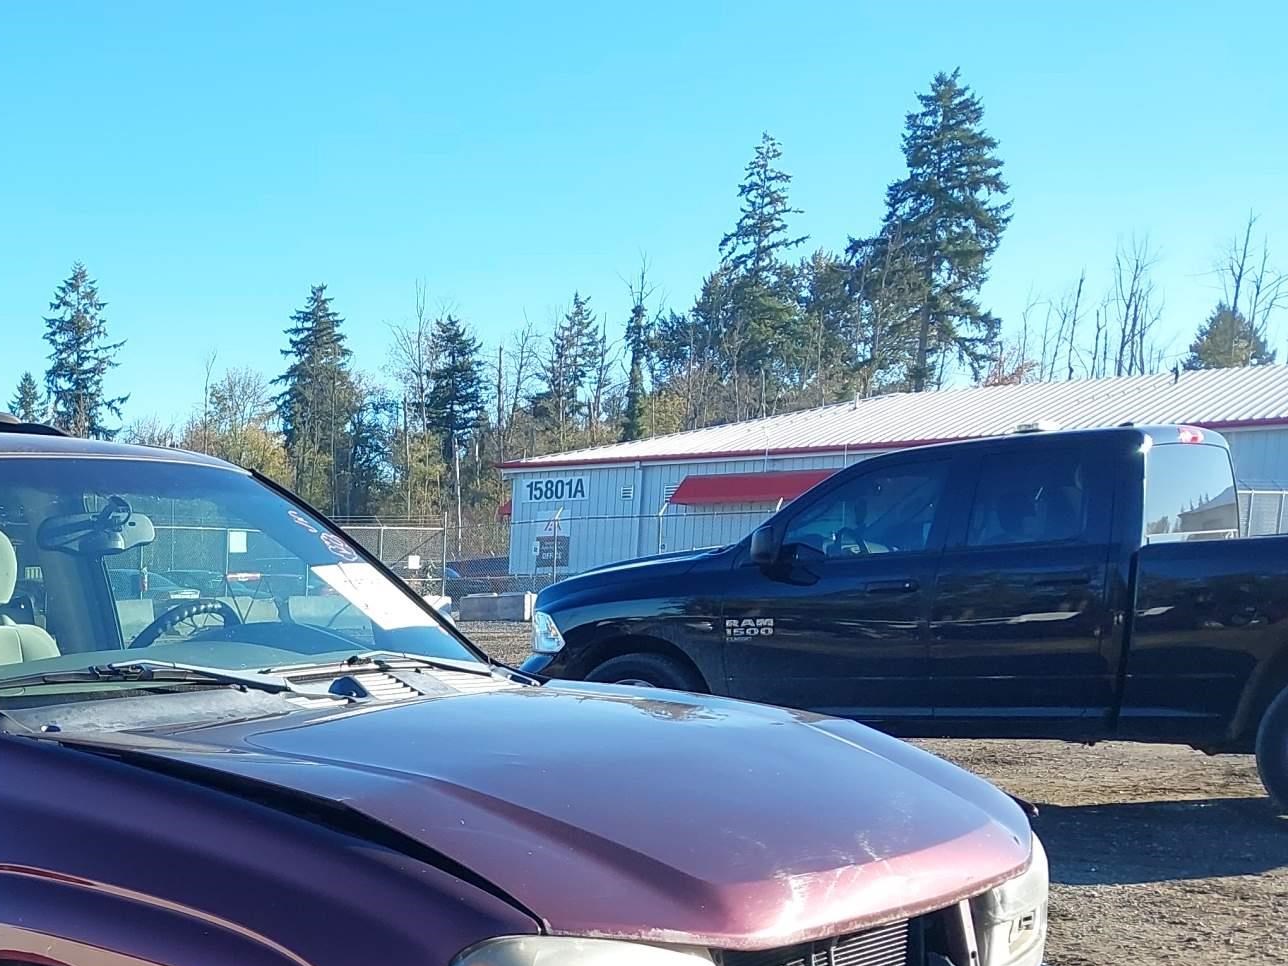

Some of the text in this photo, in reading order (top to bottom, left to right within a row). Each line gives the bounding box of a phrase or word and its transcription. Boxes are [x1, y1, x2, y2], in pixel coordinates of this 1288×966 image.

[526, 477, 585, 501] 15801A
[725, 618, 774, 627] RAM
[725, 627, 774, 636] 1500
